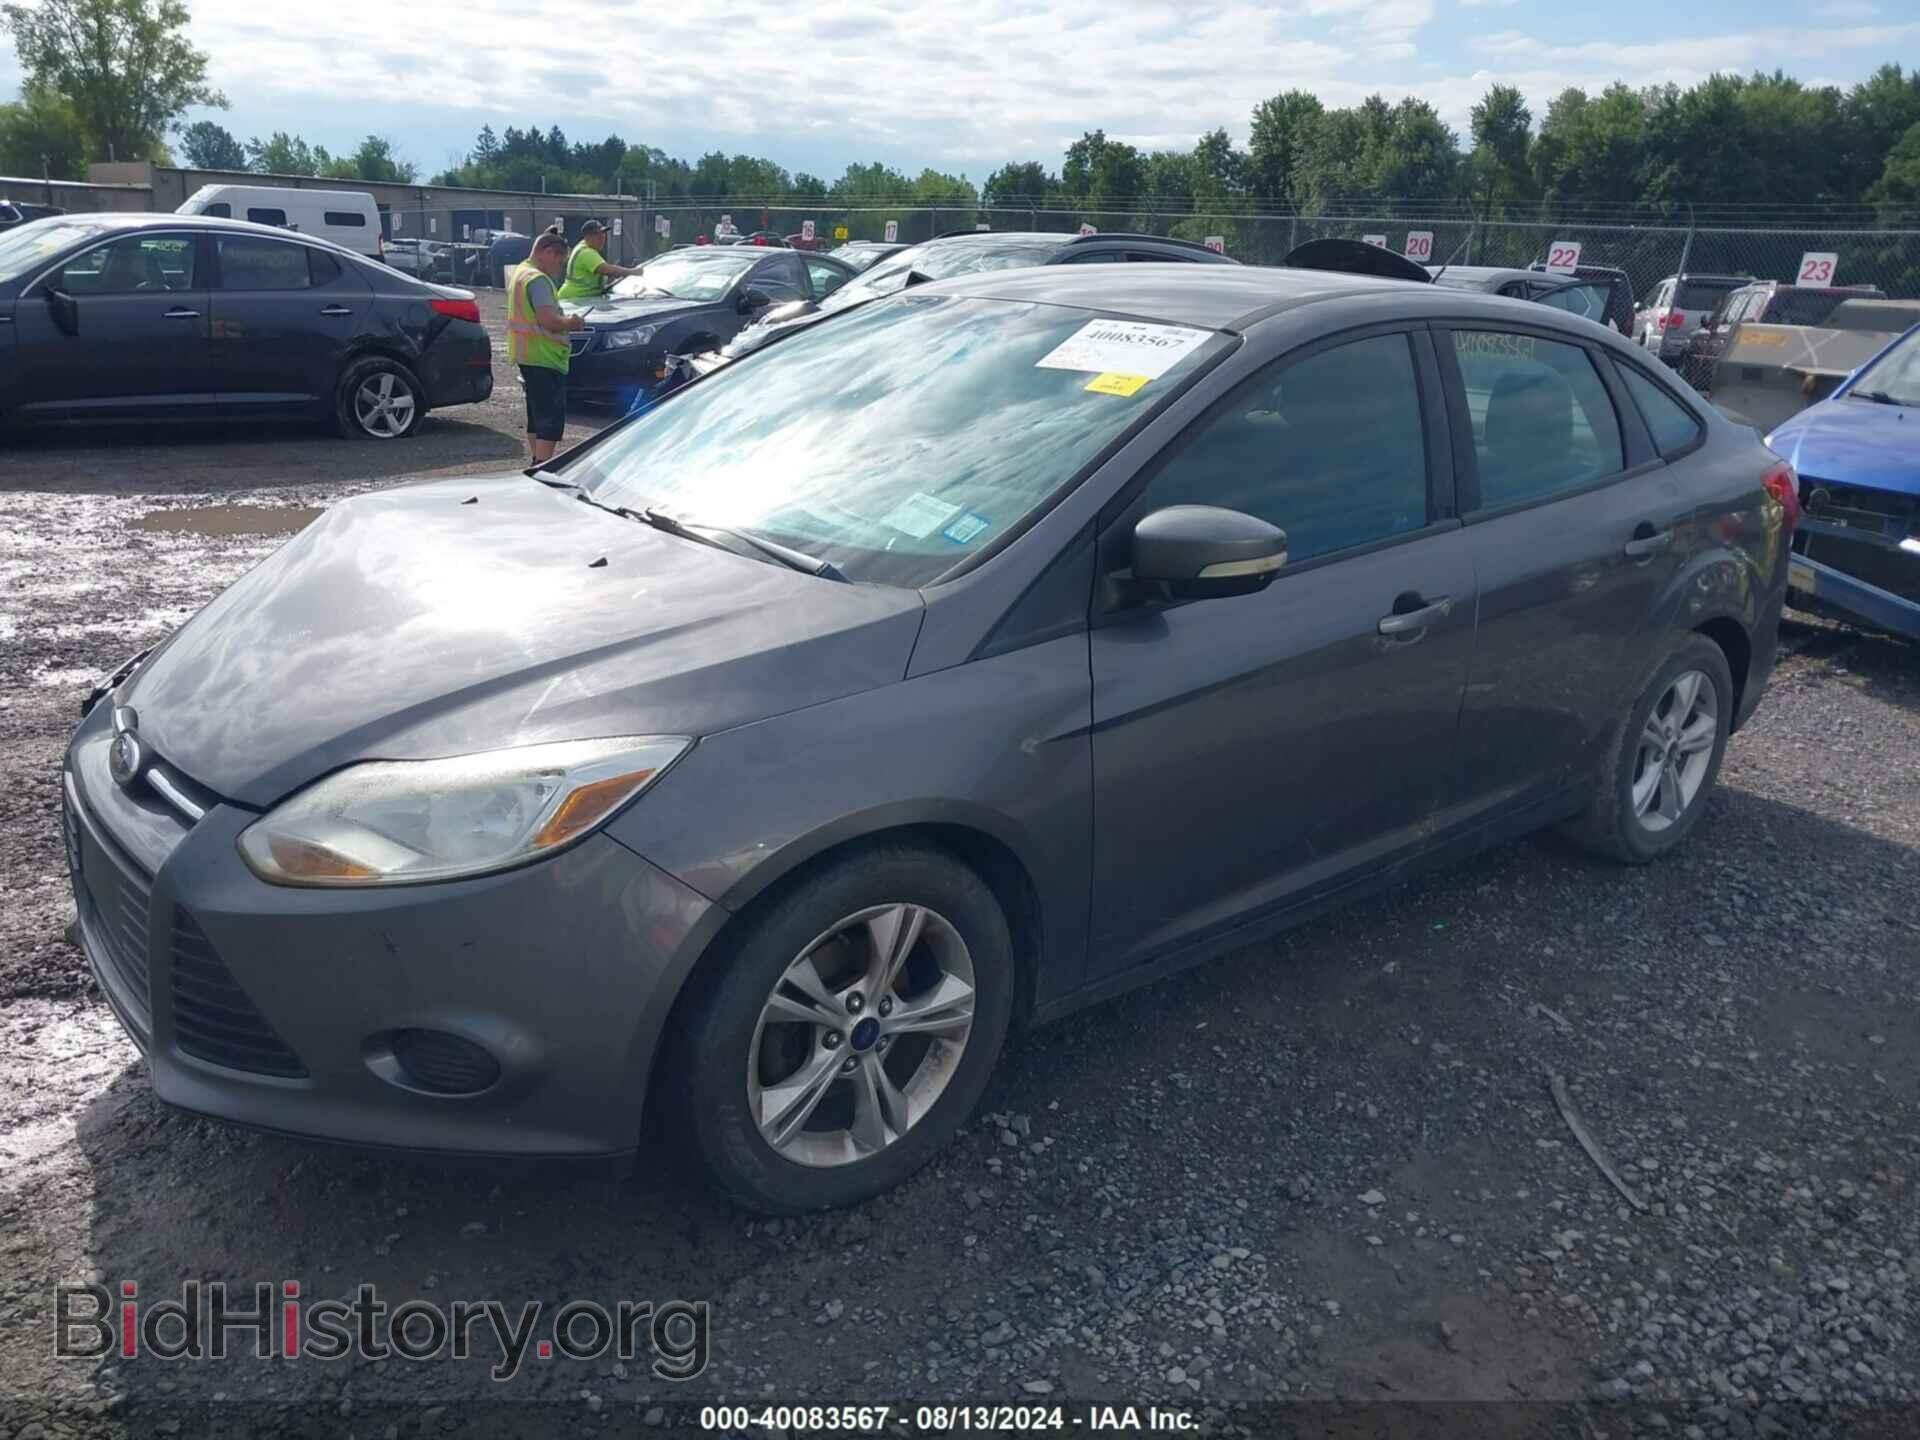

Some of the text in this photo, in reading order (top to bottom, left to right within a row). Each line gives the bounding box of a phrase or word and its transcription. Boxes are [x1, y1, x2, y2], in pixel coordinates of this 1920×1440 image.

[1408, 238, 1430, 256] 20
[1551, 249, 1577, 267] 22
[1801, 260, 1831, 281] 23
